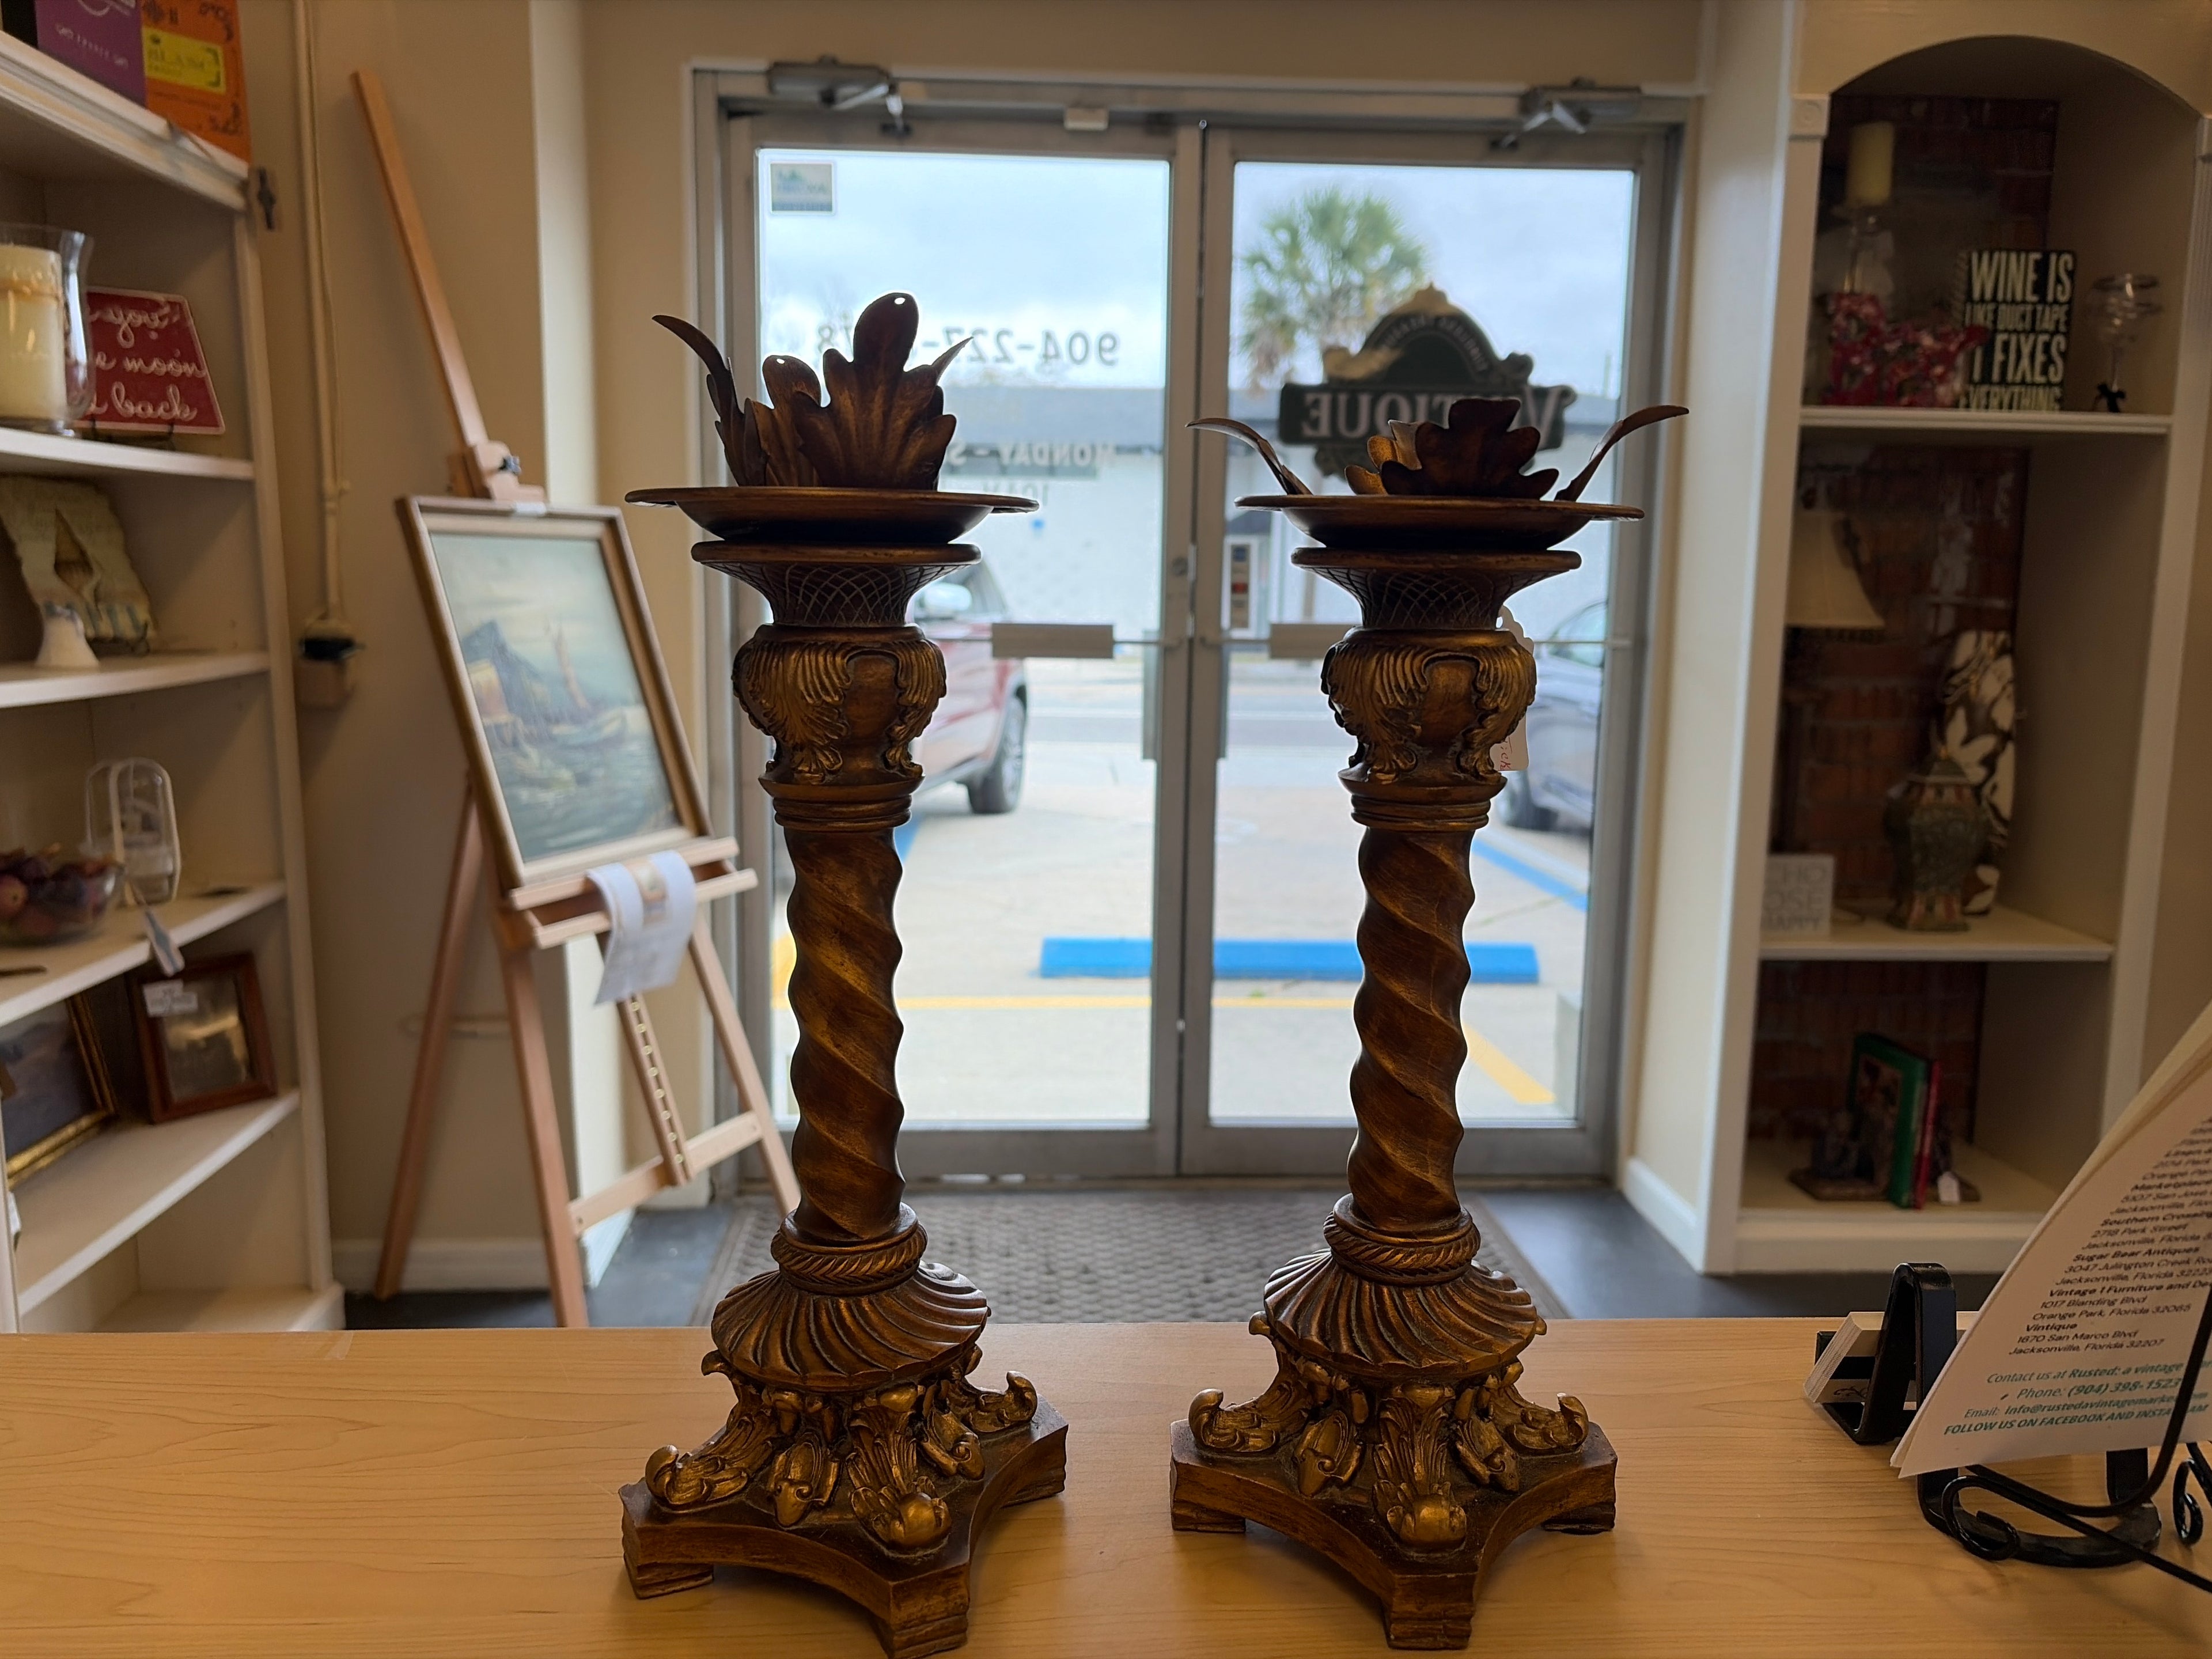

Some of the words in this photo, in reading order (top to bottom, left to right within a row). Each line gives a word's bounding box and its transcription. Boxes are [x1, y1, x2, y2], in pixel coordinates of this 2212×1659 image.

[1971, 251, 2043, 303] WINE
[2047, 252, 2074, 304] IS
[1997, 303, 2034, 332] DUCT
[2036, 303, 2070, 334] TAPE
[122, 355, 207, 378] moon
[1992, 332, 2067, 385] FIXES
[111, 381, 198, 422] back
[2101, 1215, 2160, 1227] Southern
[2073, 1252, 2109, 1263] Sugar
[2111, 1249, 2142, 1259] Bear
[2142, 1246, 2200, 1257] Antiques
[2133, 1270, 2175, 1281] Florida
[2049, 1287, 2097, 1297] Vintage
[2106, 1283, 2164, 1294] Furniture
[2166, 1281, 2192, 1291] and
[2040, 1300, 2066, 1309] 1017
[2067, 1297, 2118, 1308] Blanding
[2120, 1295, 2148, 1305] Blvd
[2032, 1312, 2077, 1321] Orange
[2109, 1306, 2150, 1317] Florida
[2026, 1322, 2078, 1332] Vintique
[2017, 1335, 2046, 1344] 1670
[2047, 1334, 2070, 1342] San
[2072, 1331, 2109, 1340] Marco
[2111, 1329, 2140, 1339] Blvd
[2084, 1341, 2124, 1351] Florida
[2126, 1338, 2165, 1349] 32207
[1987, 1372, 2035, 1384] Contact
[2036, 1372, 2051, 1381] us
[2053, 1369, 2068, 1379] at
[2068, 1366, 2121, 1378] Rusted:
[2122, 1367, 2132, 1376] a
[2134, 1362, 2184, 1374] vintage
[2017, 1388, 2063, 1400] Phone:
[2067, 1382, 2110, 1399] (904)
[1944, 1421, 1999, 1435] FOLLOW
[1998, 1419, 2017, 1430] US
[2017, 1417, 2039, 1429] ON
[2039, 1412, 2106, 1427] FACEBOOK
[2105, 1411, 2134, 1422] AND
[2133, 1404, 2209, 1420] INSTAAM
[1964, 1406, 2001, 1419] Email:
